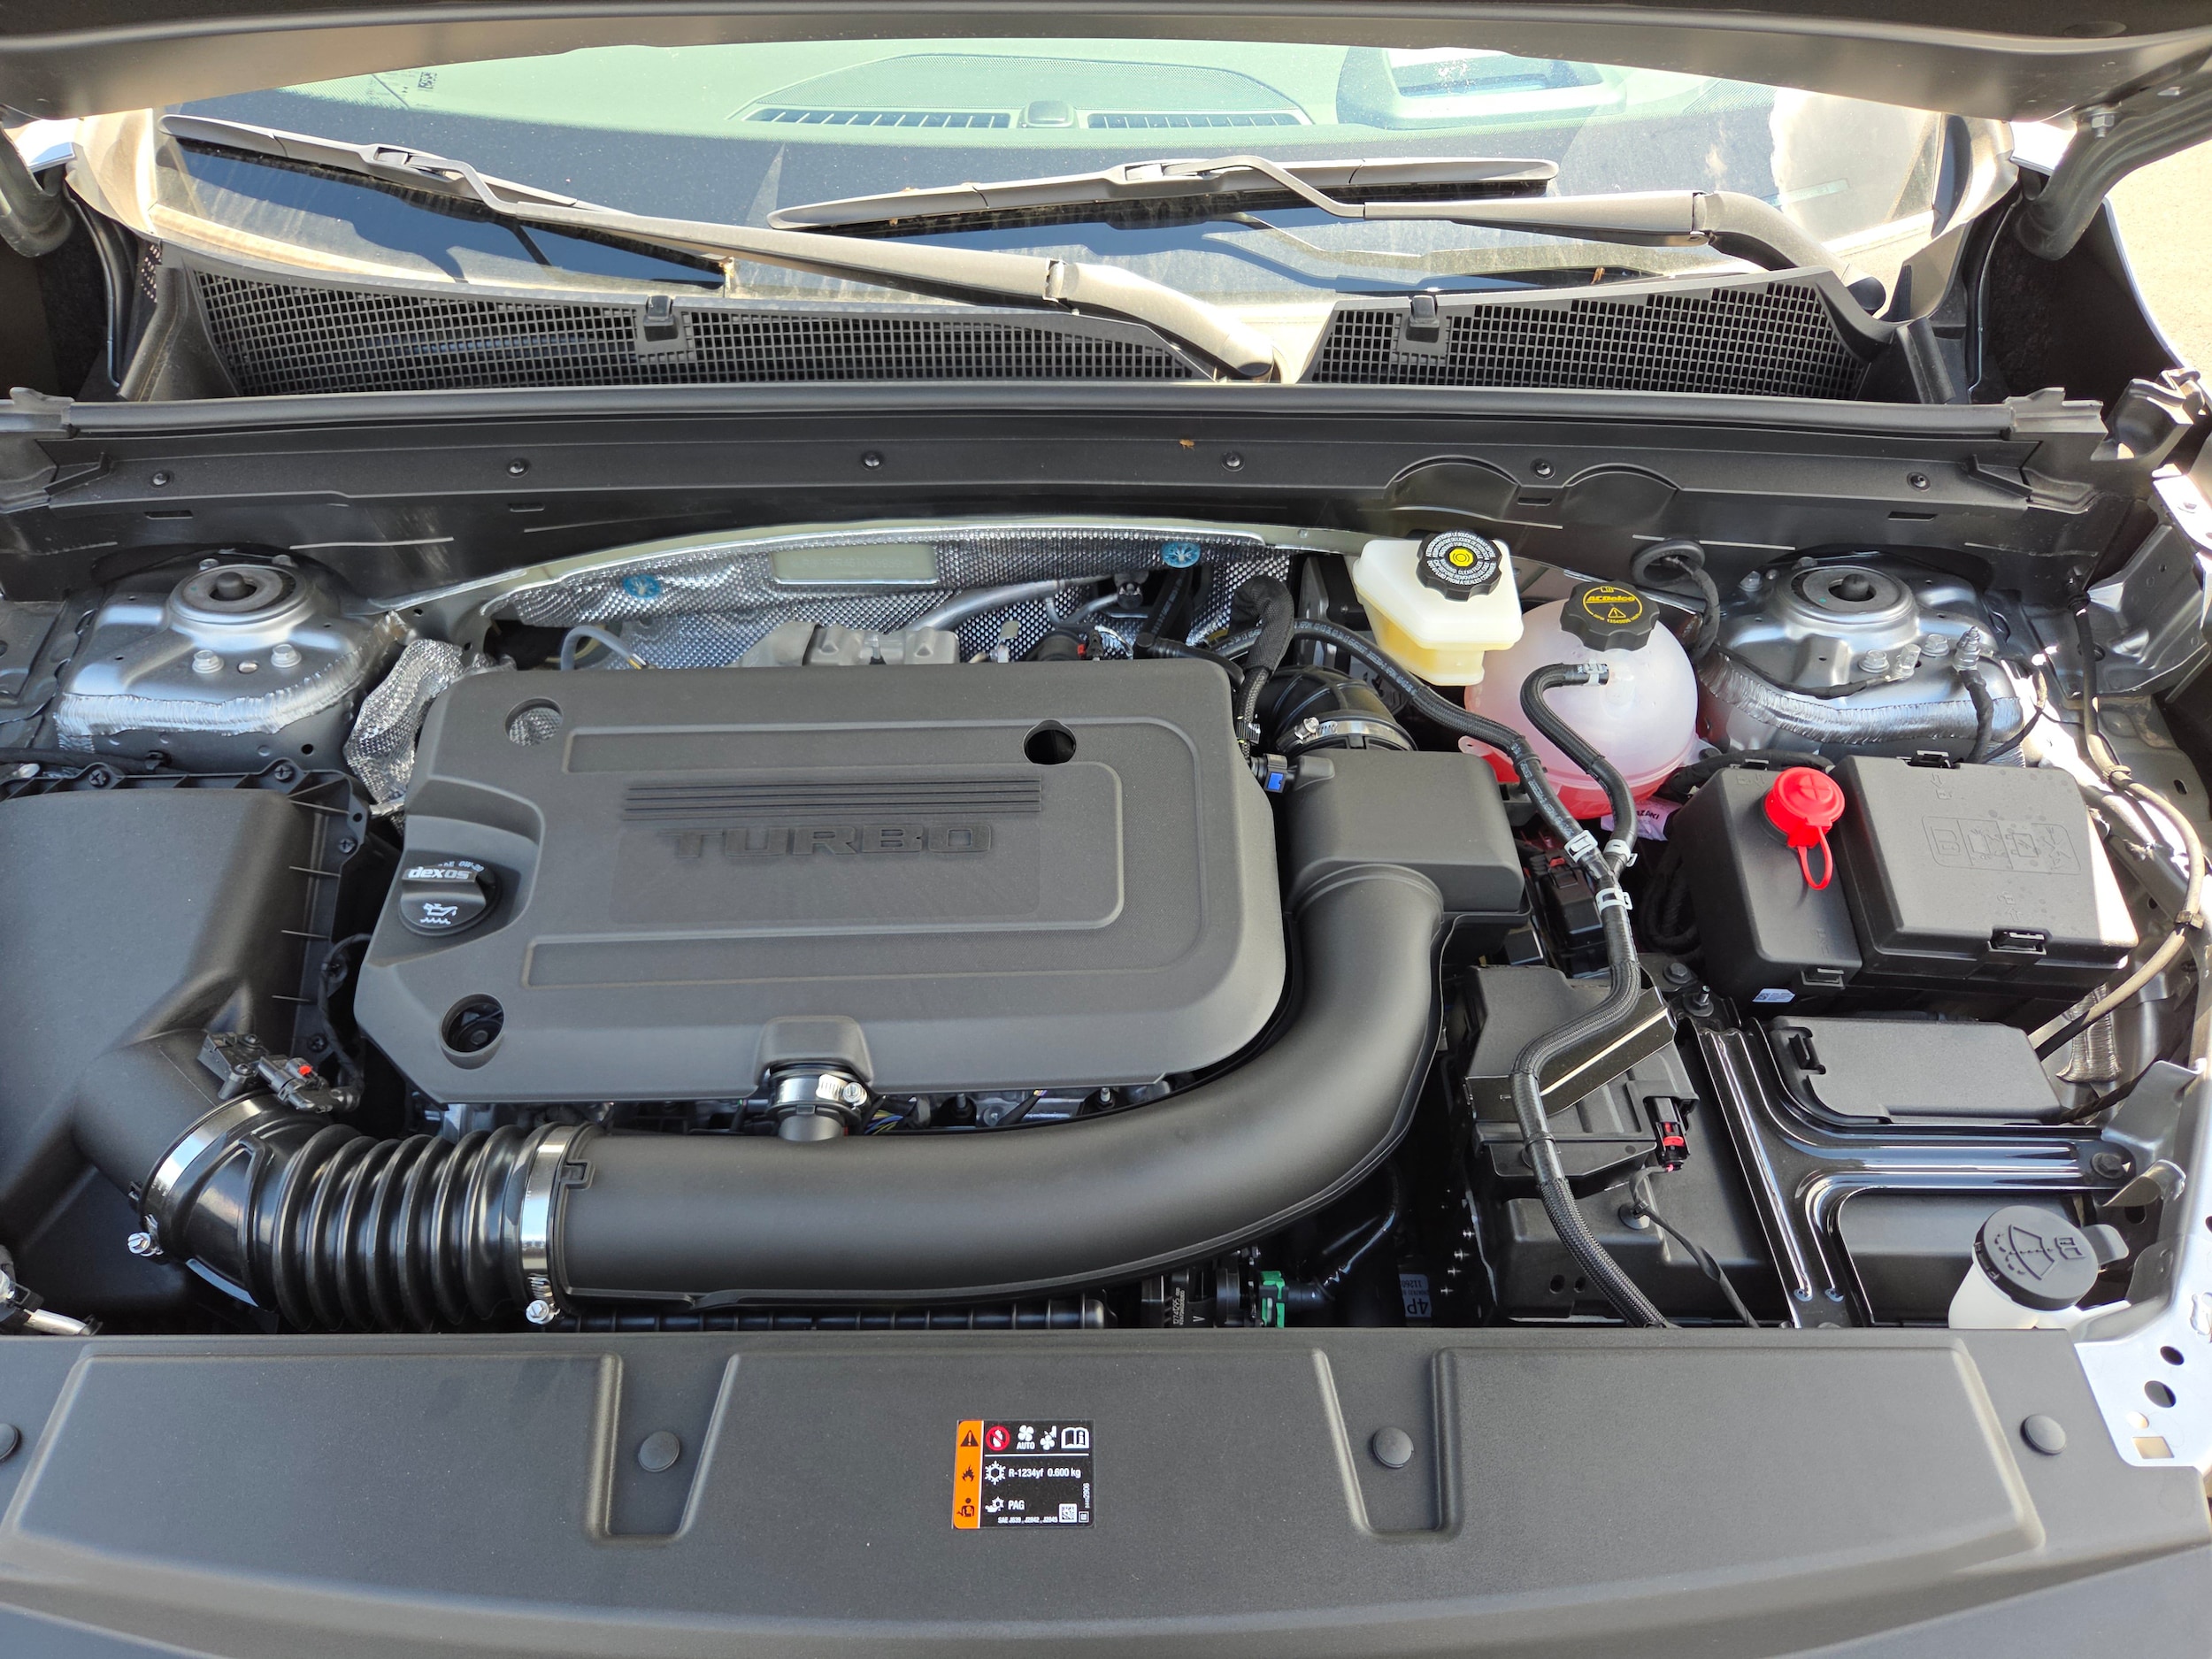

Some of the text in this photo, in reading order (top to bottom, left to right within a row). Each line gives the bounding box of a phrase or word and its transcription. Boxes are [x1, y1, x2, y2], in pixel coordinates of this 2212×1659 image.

[1636, 810, 1660, 820] AZAKI
[657, 824, 993, 858] TURBO
[408, 866, 472, 879] dexos
[1407, 1297, 1429, 1315] 4P
[1008, 1467, 1081, 1479] R-1234yf 0.600 kg
[1008, 1500, 1025, 1510] PAG
